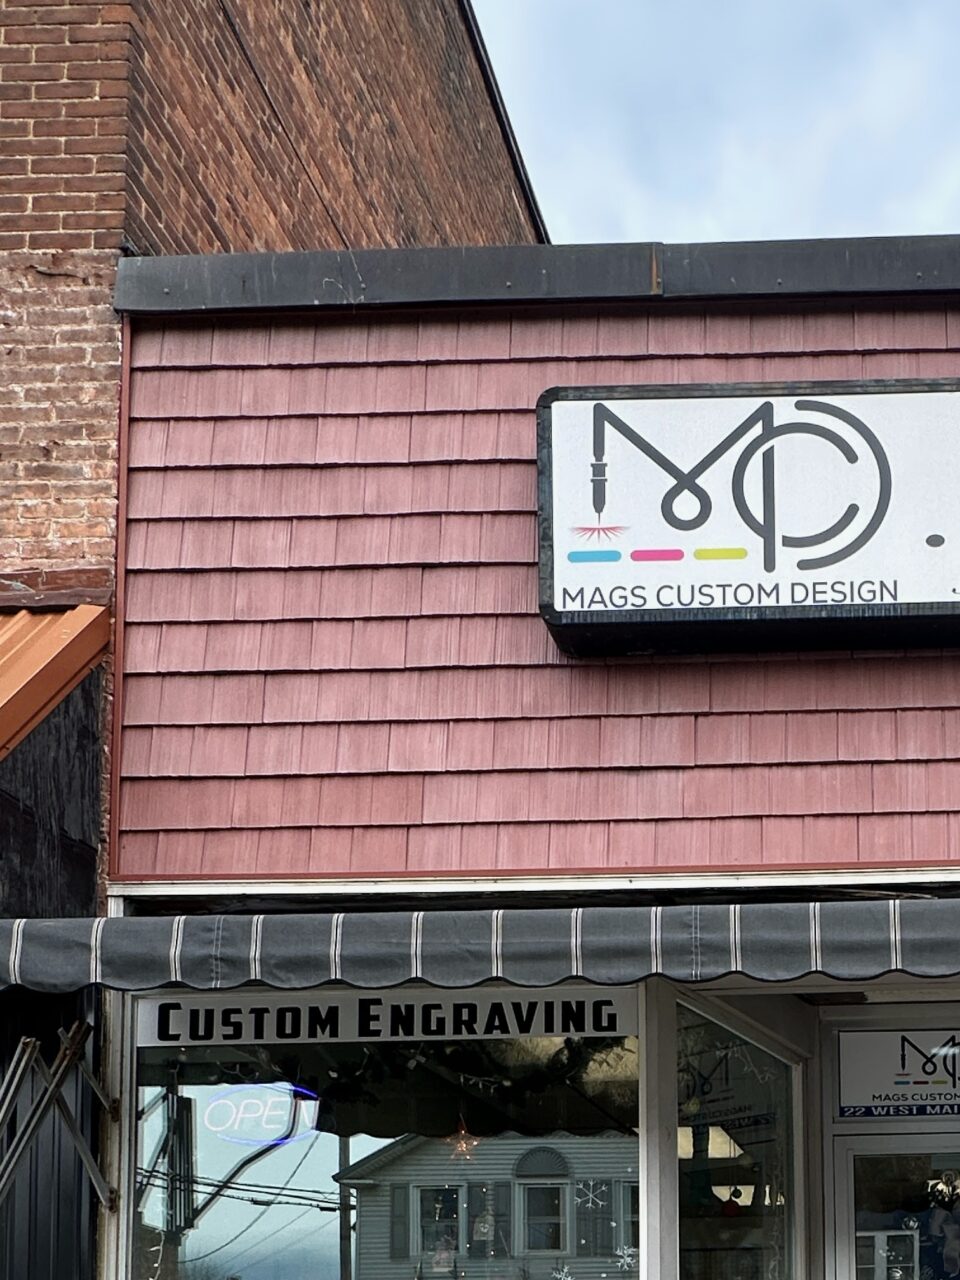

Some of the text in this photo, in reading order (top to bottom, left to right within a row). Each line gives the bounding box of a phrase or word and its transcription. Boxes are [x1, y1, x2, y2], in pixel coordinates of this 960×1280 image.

[563, 579, 898, 610] MAGS CUSTOM DESIGN
[157, 998, 618, 1041] CUSTOM ENGRAVING
[204, 1096, 320, 1131] OPEN
[844, 1107, 865, 1116] 22
[872, 1106, 918, 1115] WEST
[872, 1094, 908, 1102] MAGS
